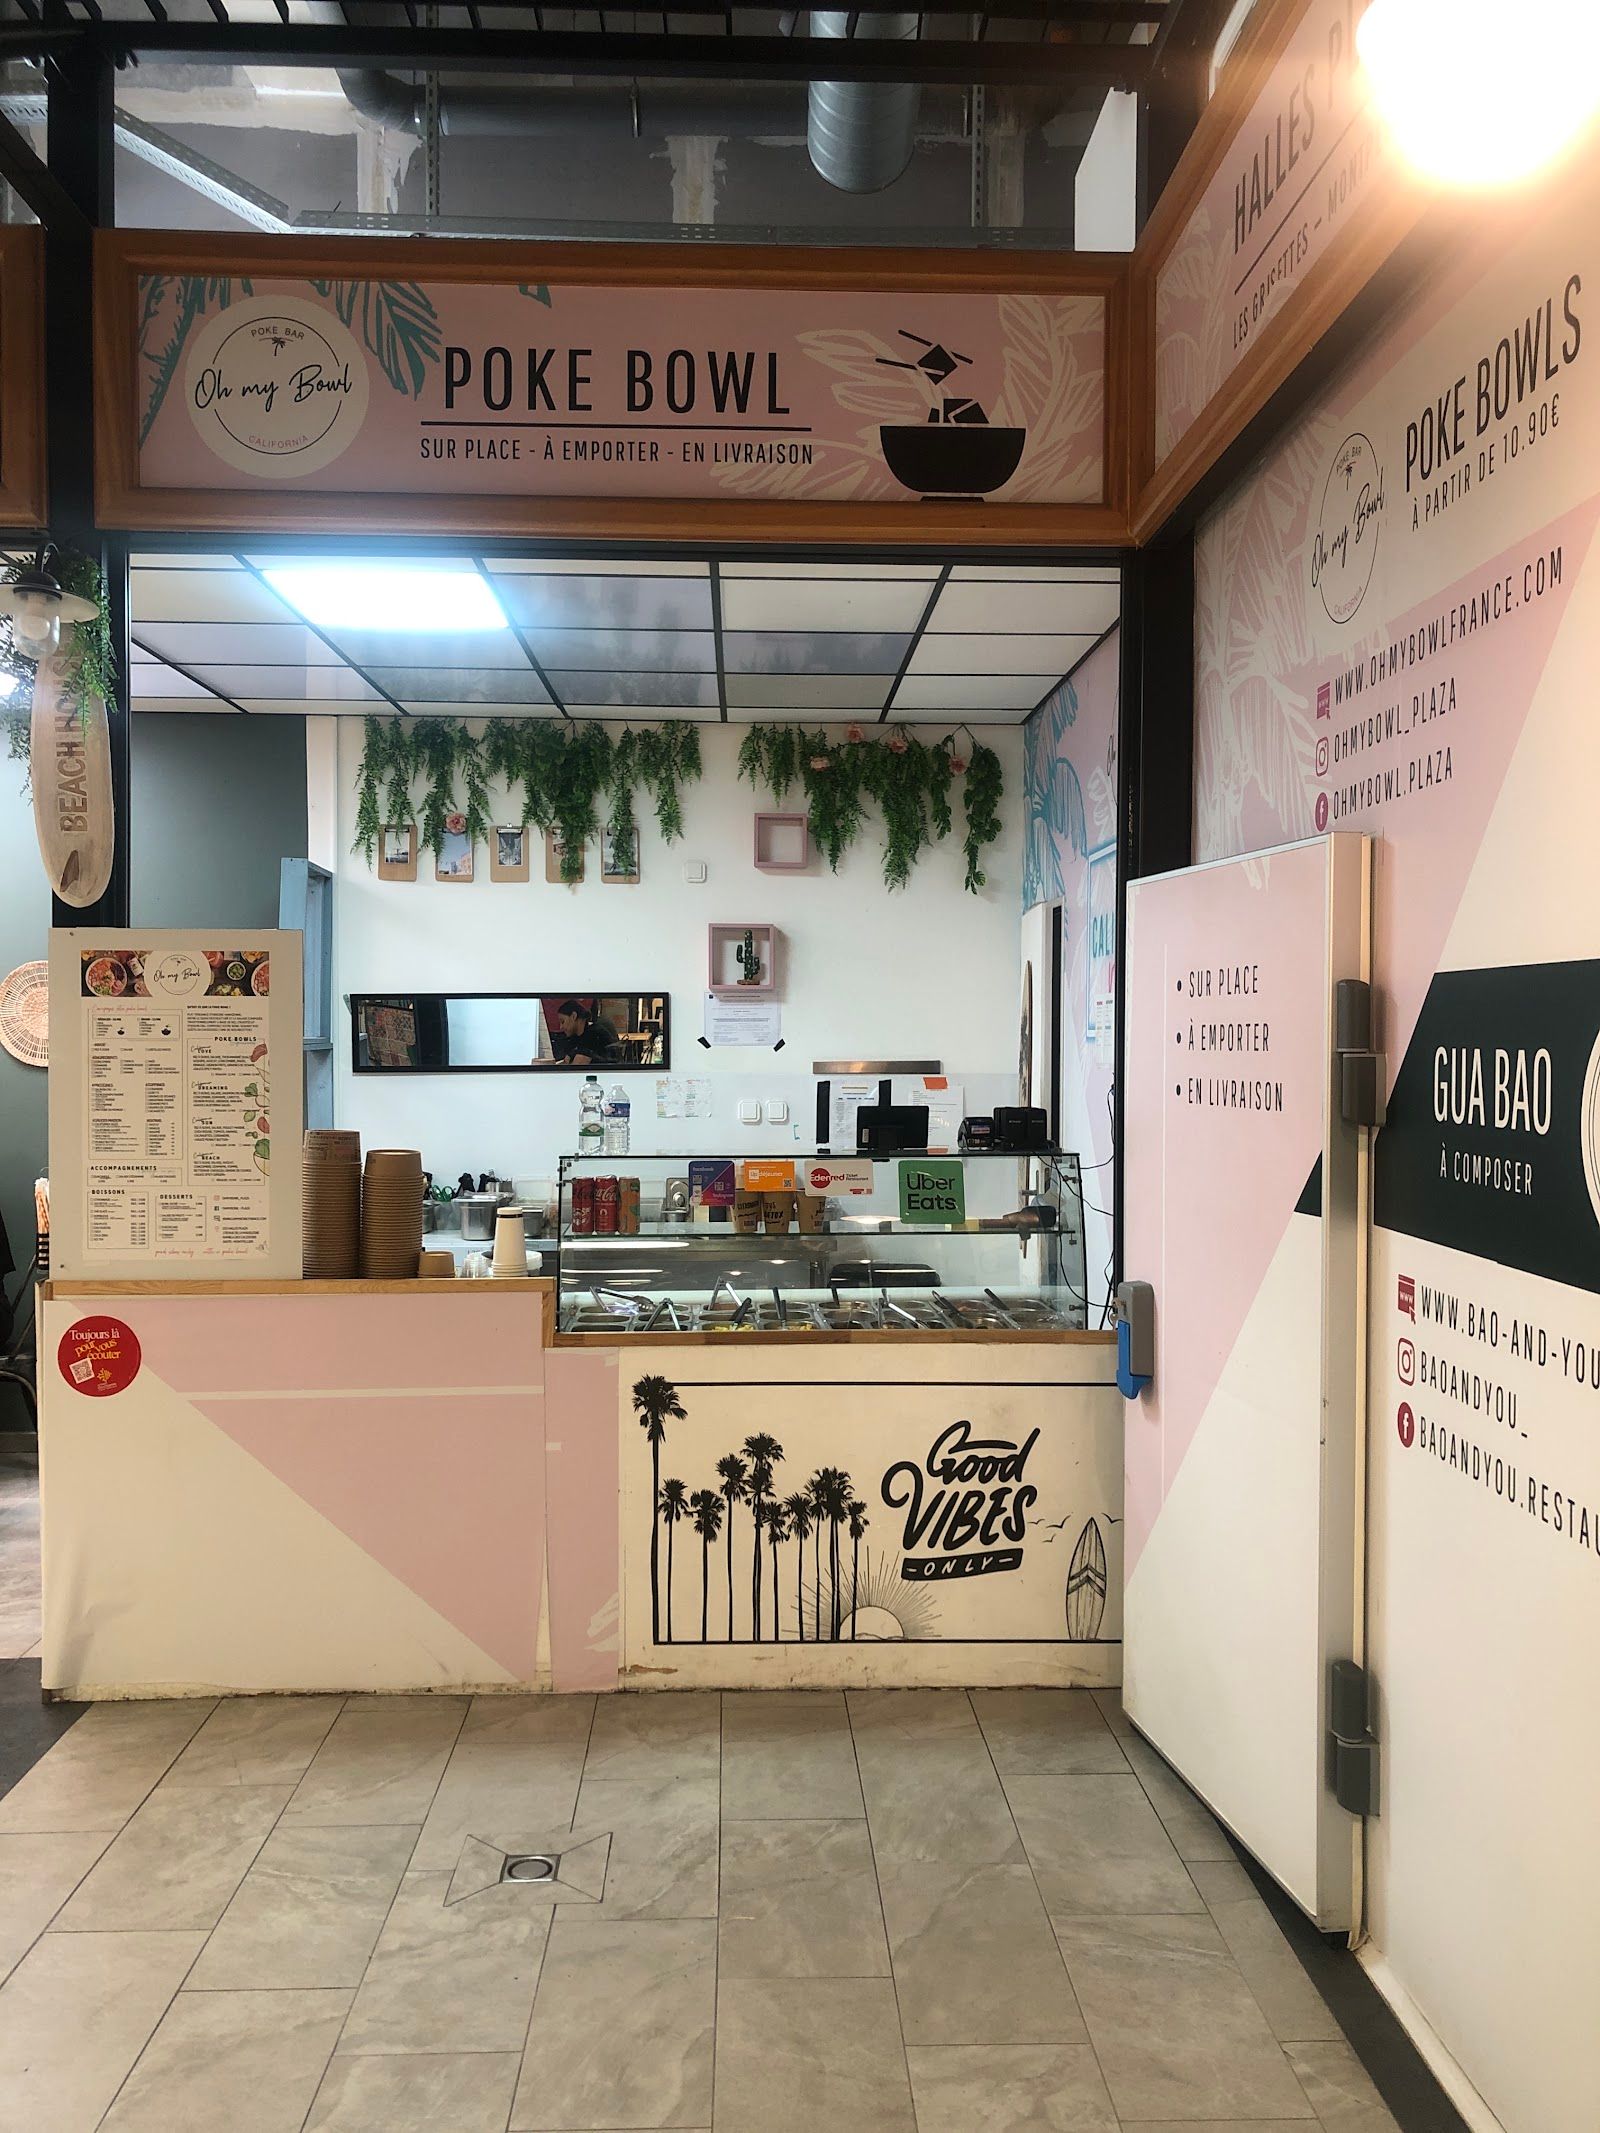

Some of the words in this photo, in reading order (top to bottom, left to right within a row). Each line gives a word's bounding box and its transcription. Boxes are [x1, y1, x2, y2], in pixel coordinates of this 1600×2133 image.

[1234, 63, 1315, 254] HALLES
[250, 326, 278, 339] POKE
[284, 327, 305, 341] BAR
[1233, 307, 1248, 349] LES
[195, 368, 233, 409] Oh
[241, 380, 279, 413] my
[288, 363, 352, 403] Bowl
[444, 346, 592, 411] POKE
[626, 349, 790, 414] BOWL
[1406, 376, 1466, 493] POKE
[1476, 273, 1582, 437] BOWLS
[248, 434, 309, 449] CALIFORNIA
[420, 438, 456, 459] SUR
[465, 438, 521, 460] PLACE
[543, 434, 554, 461] À
[562, 440, 659, 462] EMPORTER
[682, 441, 704, 463] EN
[714, 442, 813, 464] LIVRAISON
[1336, 451, 1350, 473] POKE
[1351, 446, 1362, 458] BAR
[1412, 496, 1419, 532] À
[1425, 463, 1471, 522] PARTIR
[1479, 443, 1496, 482] DE
[1503, 392, 1560, 464] 10.90€
[1312, 530, 1328, 588] Oh
[1331, 525, 1349, 568] my
[1353, 466, 1385, 544] Bowl
[1335, 546, 1562, 706] WWW.OHMYBOWLFRANCE.COM
[1334, 677, 1457, 763] OHMYBOWL_PLAZA
[55, 741, 88, 833] BEACH
[1333, 747, 1453, 820] OHMYBOWL.PLAZA
[1189, 970, 1211, 998] SUR
[1218, 965, 1258, 996] PLACE
[1188, 1018, 1195, 1051] À
[1201, 1023, 1269, 1051] EMPORTER
[1188, 1078, 1202, 1105] EN
[1209, 1079, 1283, 1112] LIVRAISON
[1434, 1046, 1486, 1127] GUA
[1494, 1048, 1552, 1135] BAO
[810, 1173, 845, 1182] Edenred
[906, 1172, 956, 1191] Uber
[1440, 1142, 1447, 1178] À
[1454, 1151, 1533, 1196] COMPOSER
[907, 1193, 957, 1210] Eats
[69, 1329, 110, 1342] Toujours
[111, 1328, 120, 1338] là
[75, 1340, 95, 1357] pour
[95, 1339, 117, 1352] vous
[87, 1350, 121, 1360] écouter
[1420, 1350, 1528, 1438] BAOANDYOU_
[926, 1420, 1041, 1485] Good
[881, 1461, 1038, 1551] VIBES
